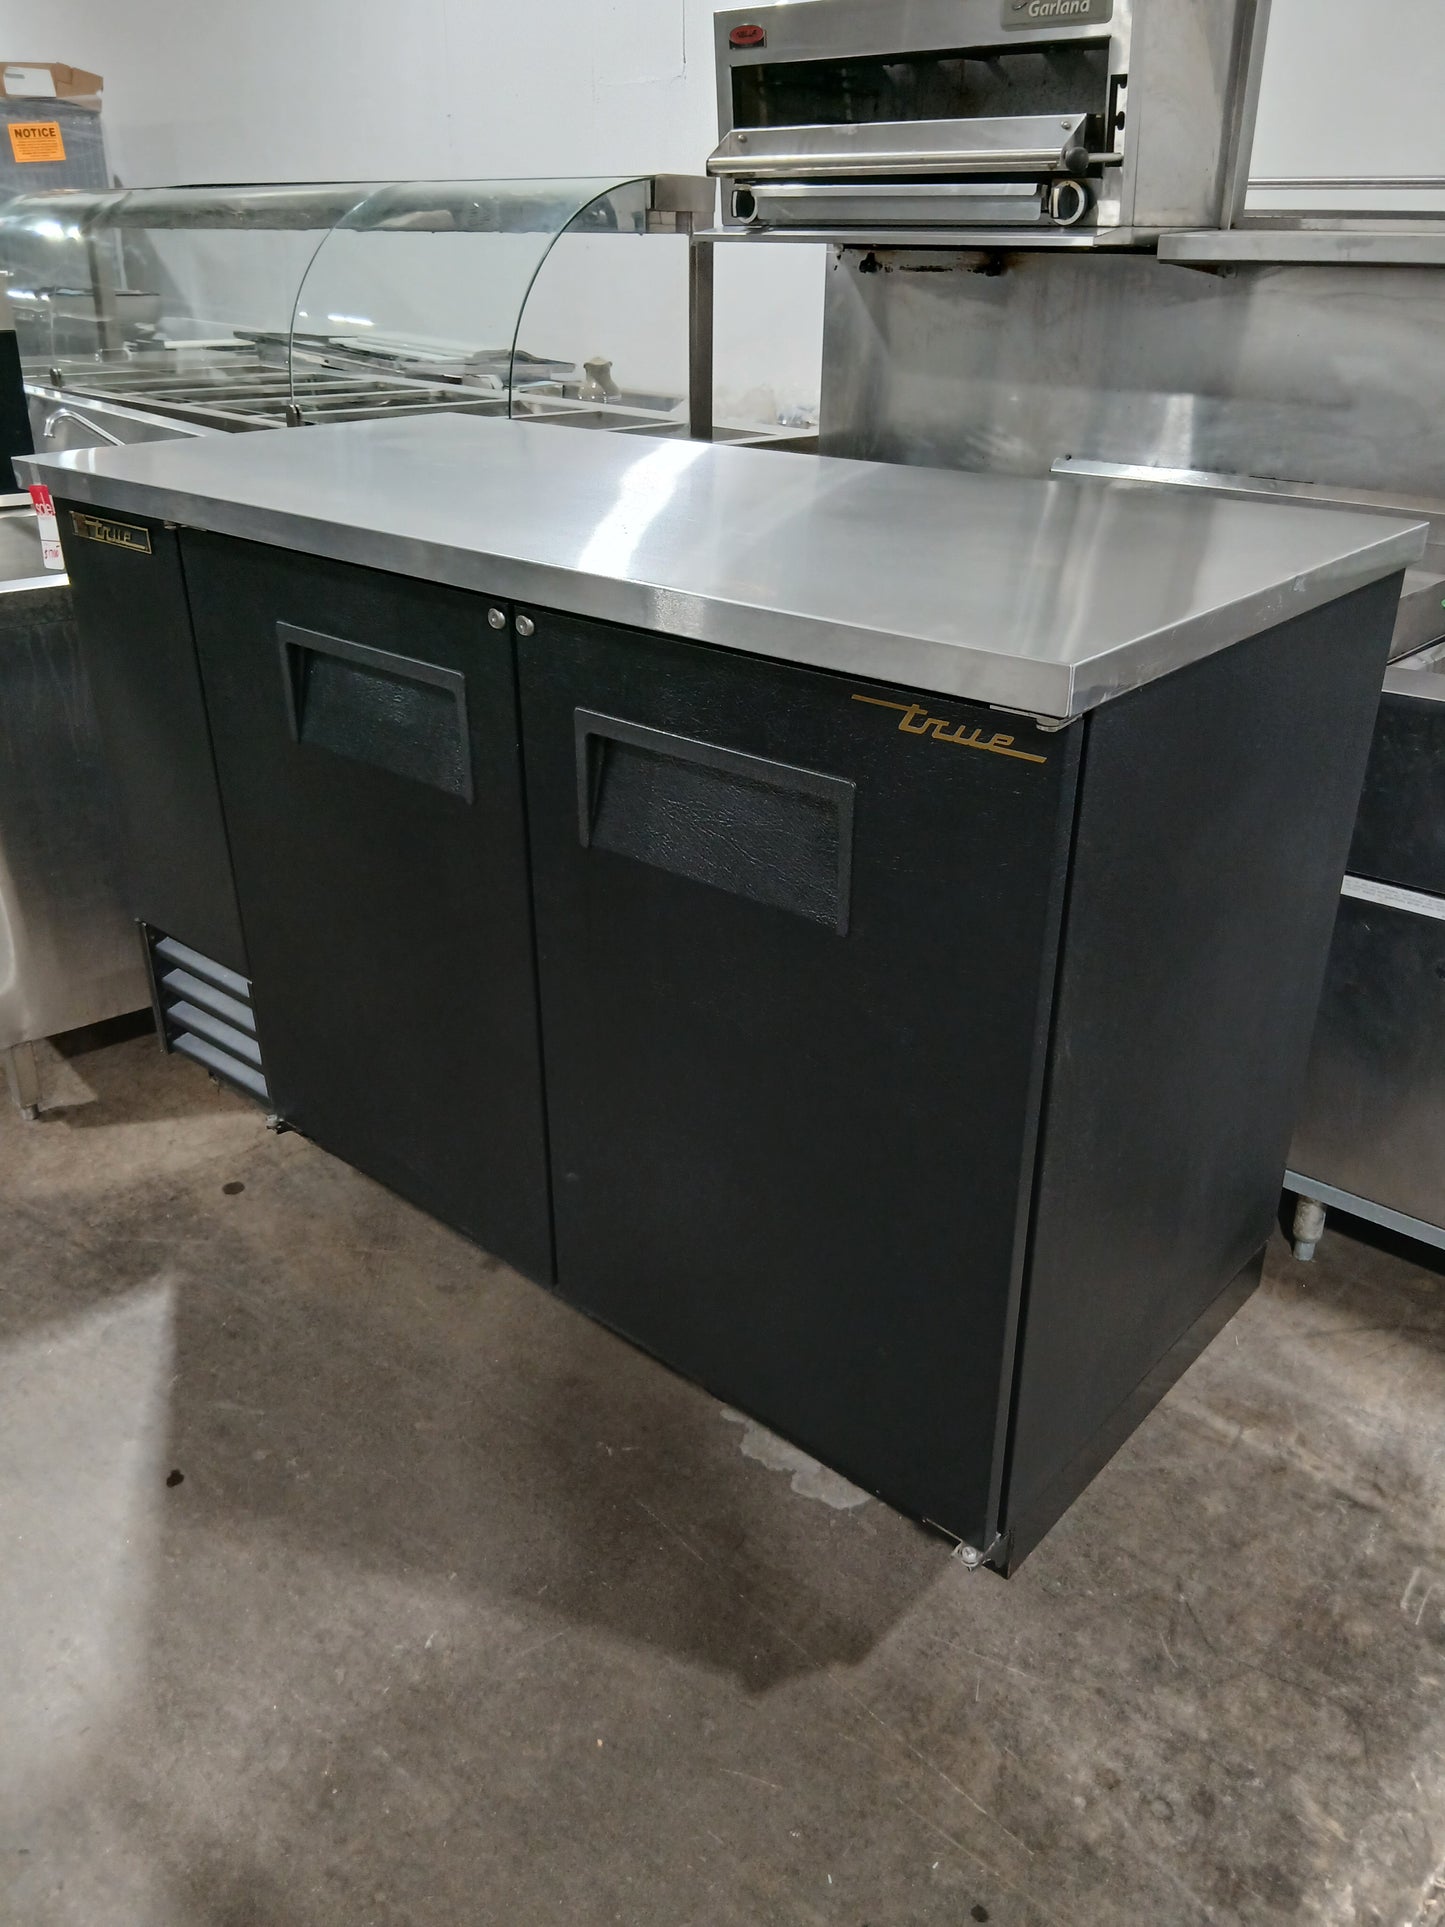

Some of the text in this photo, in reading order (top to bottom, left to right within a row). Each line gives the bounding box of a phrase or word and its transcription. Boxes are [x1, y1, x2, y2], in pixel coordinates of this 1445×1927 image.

[1028, 0, 1091, 17] Garland
[14, 127, 56, 138] NOTICE
[84, 520, 146, 550] true
[851, 694, 1048, 764] true
